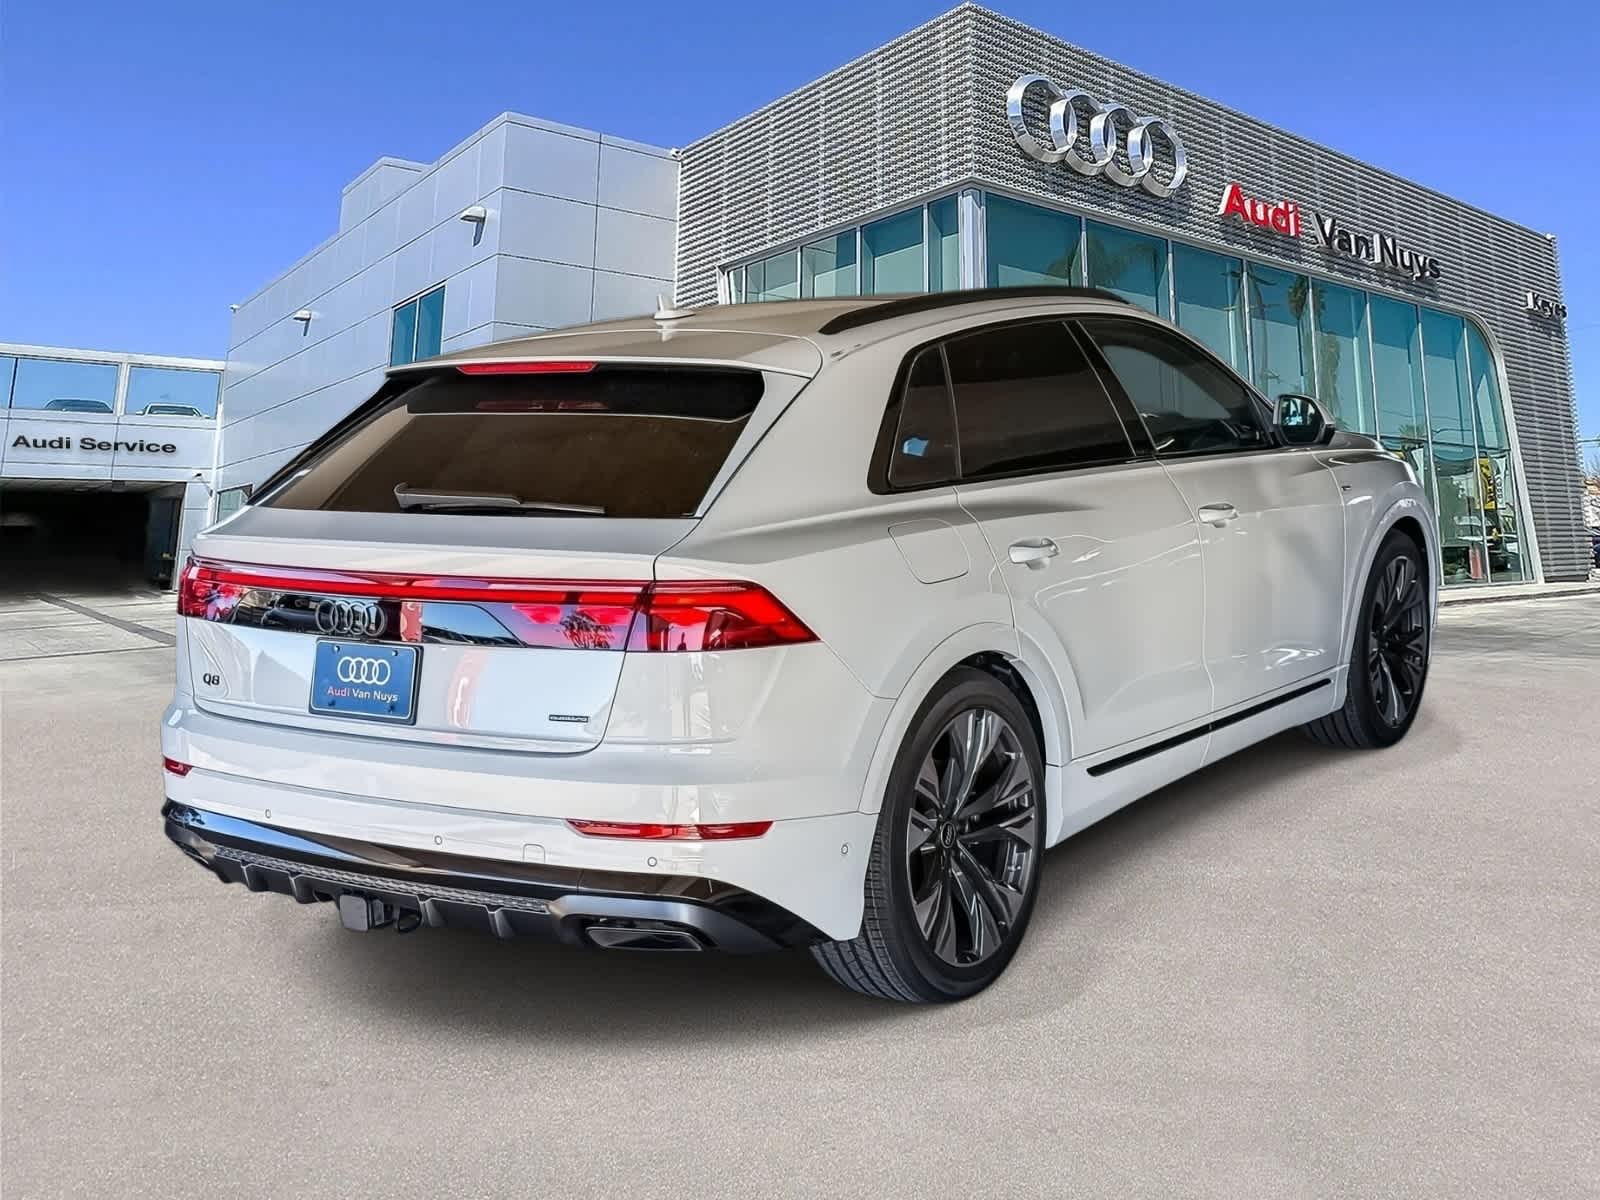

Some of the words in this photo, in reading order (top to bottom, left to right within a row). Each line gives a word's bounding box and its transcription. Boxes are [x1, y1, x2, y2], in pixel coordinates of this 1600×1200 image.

[1218, 182, 1301, 237] Audi
[1312, 213, 1373, 258] Van
[1374, 233, 1441, 280] Nuys
[12, 435, 71, 449] Audi
[80, 437, 177, 453] Service
[203, 672, 220, 686] Q8
[327, 685, 350, 698] Audi
[352, 688, 371, 701] Van
[373, 691, 399, 703] Nuys
